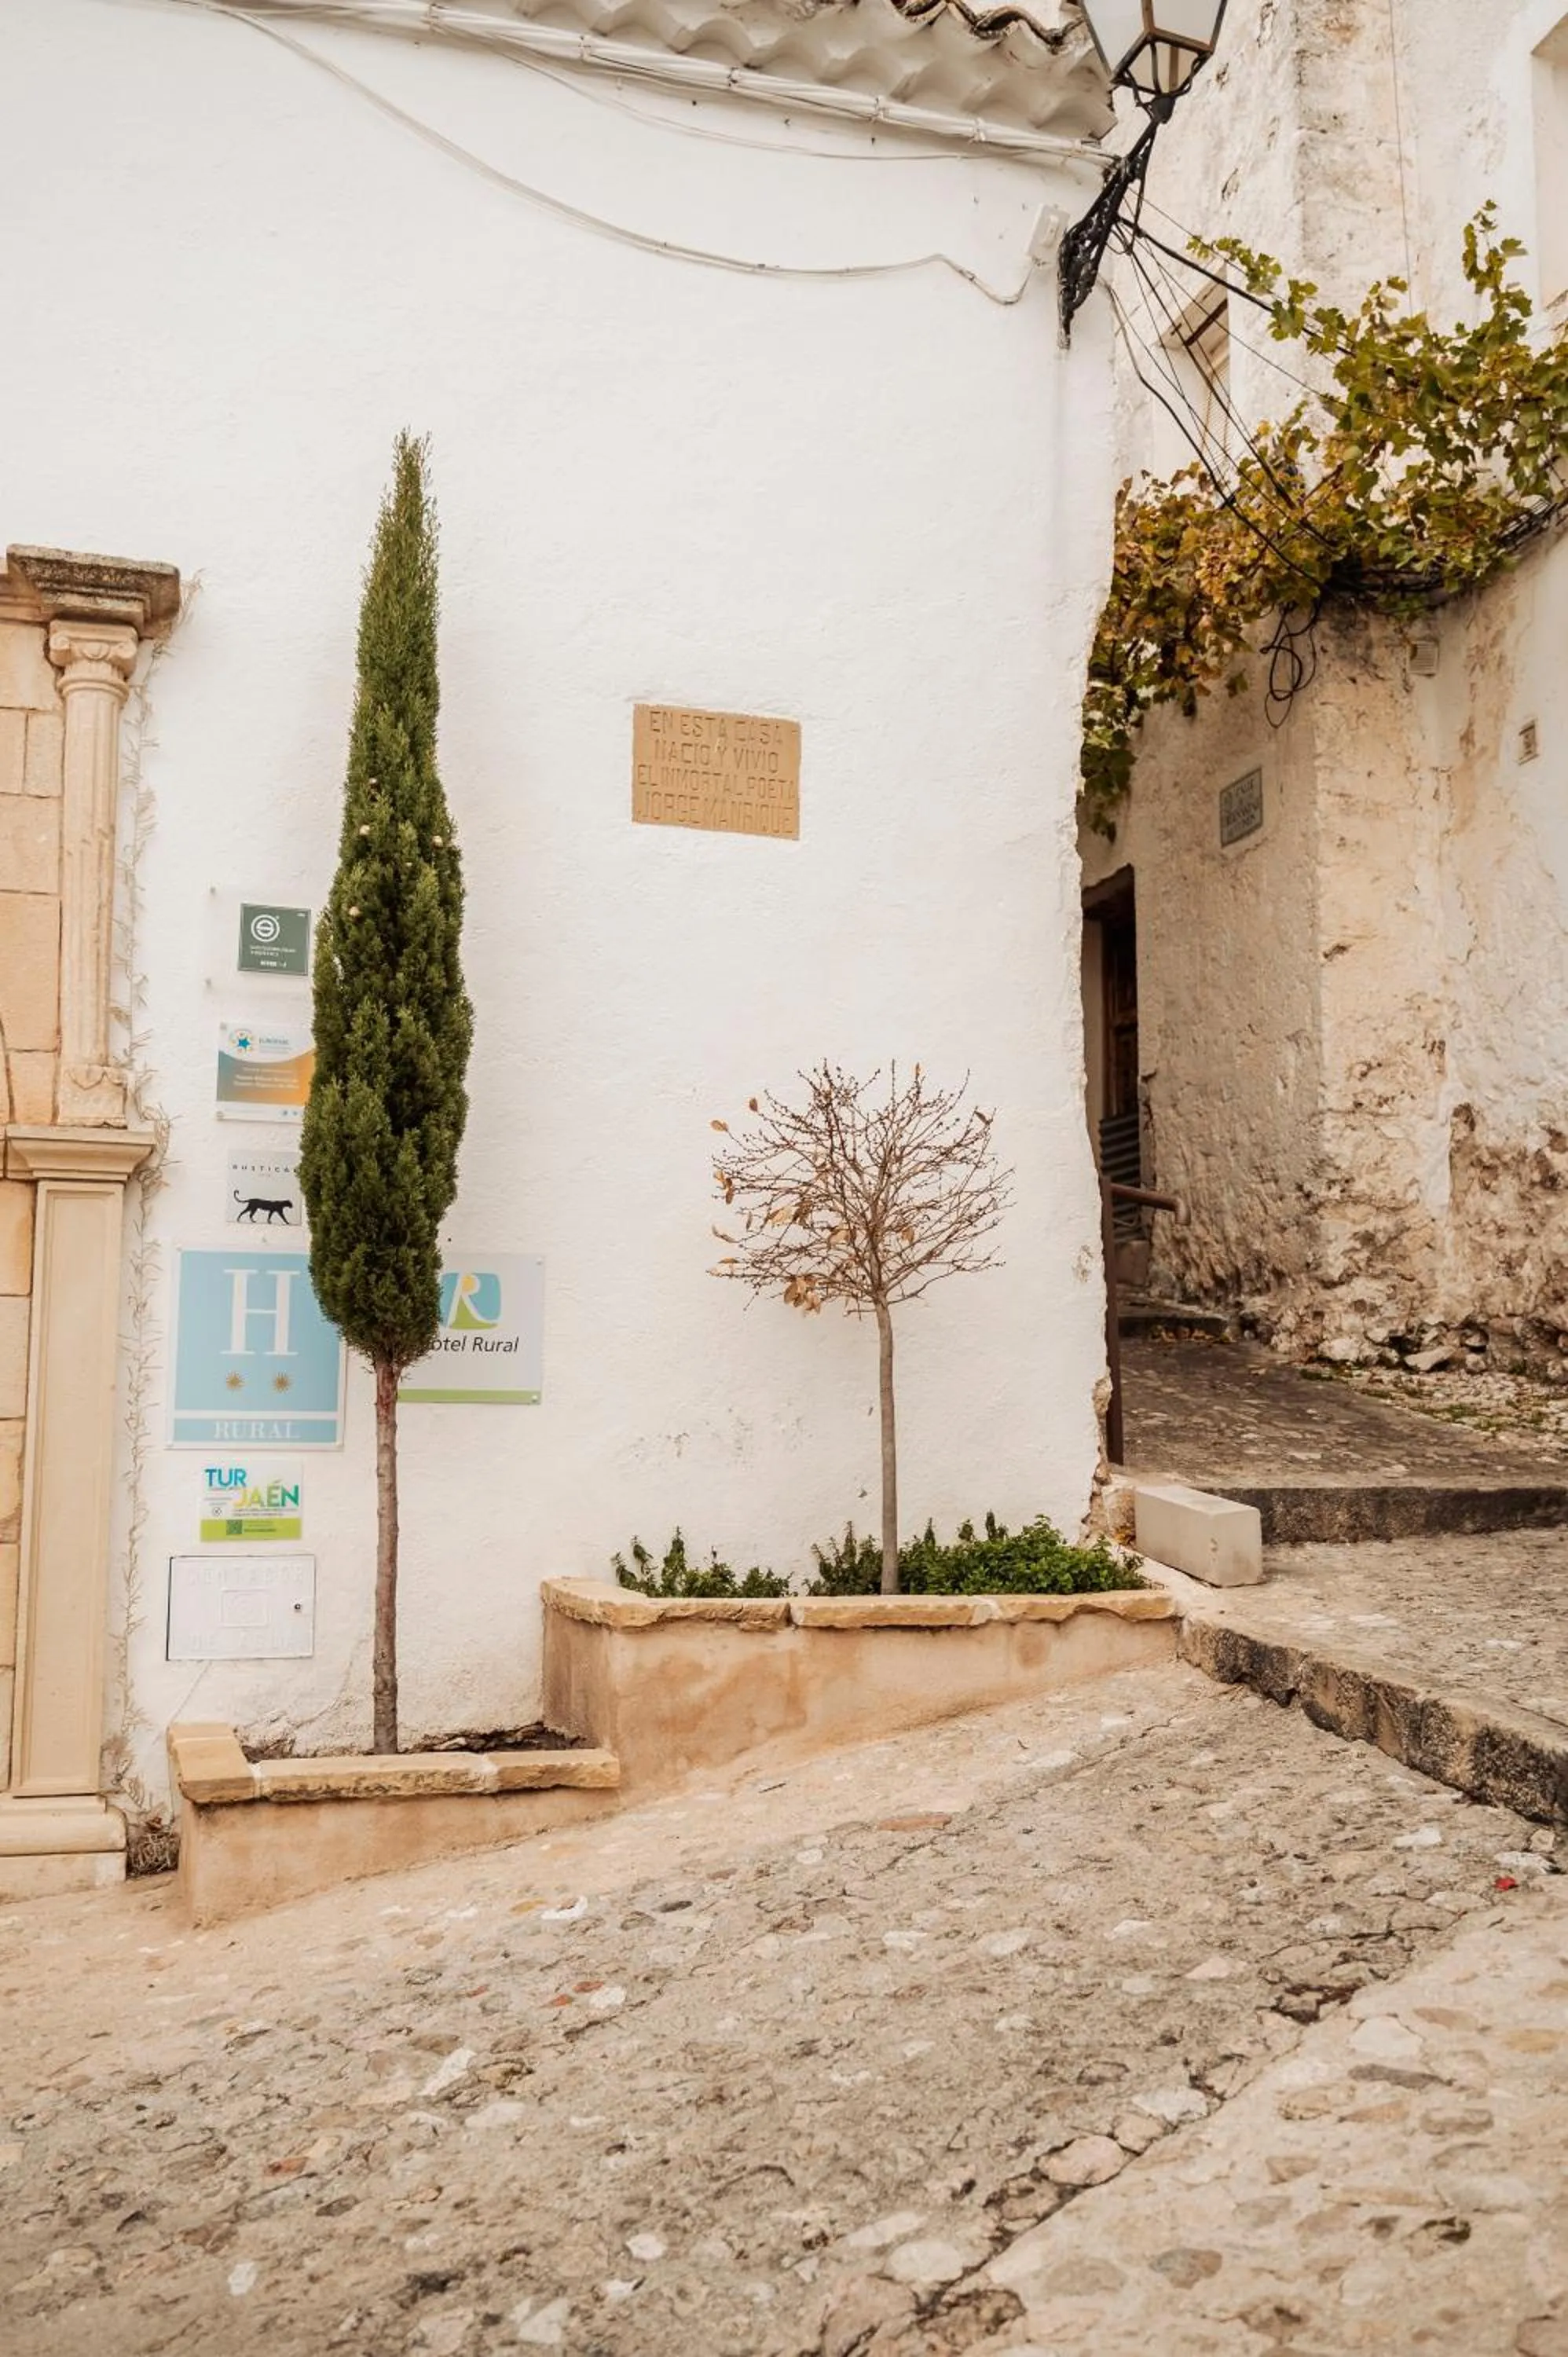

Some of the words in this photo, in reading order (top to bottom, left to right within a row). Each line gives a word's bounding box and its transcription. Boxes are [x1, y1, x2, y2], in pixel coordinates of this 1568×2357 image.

[650, 710, 673, 735] EN
[680, 713, 728, 740] ESTA
[734, 720, 783, 746] CASA
[654, 739, 711, 766] NACIO
[716, 746, 727, 769] Y
[734, 746, 779, 775] VIVIO
[637, 764, 658, 786] EL
[747, 775, 796, 800] POETA
[638, 790, 700, 825] JORGE
[704, 797, 794, 834] MANRIQUE
[232, 1164, 299, 1174] RUSTICA
[220, 1269, 301, 1356] H
[429, 1336, 467, 1352] otel
[472, 1336, 519, 1352] Rural
[214, 1420, 302, 1439] RURAL
[205, 1468, 247, 1487] TUR
[233, 1479, 299, 1508] JAÉN
